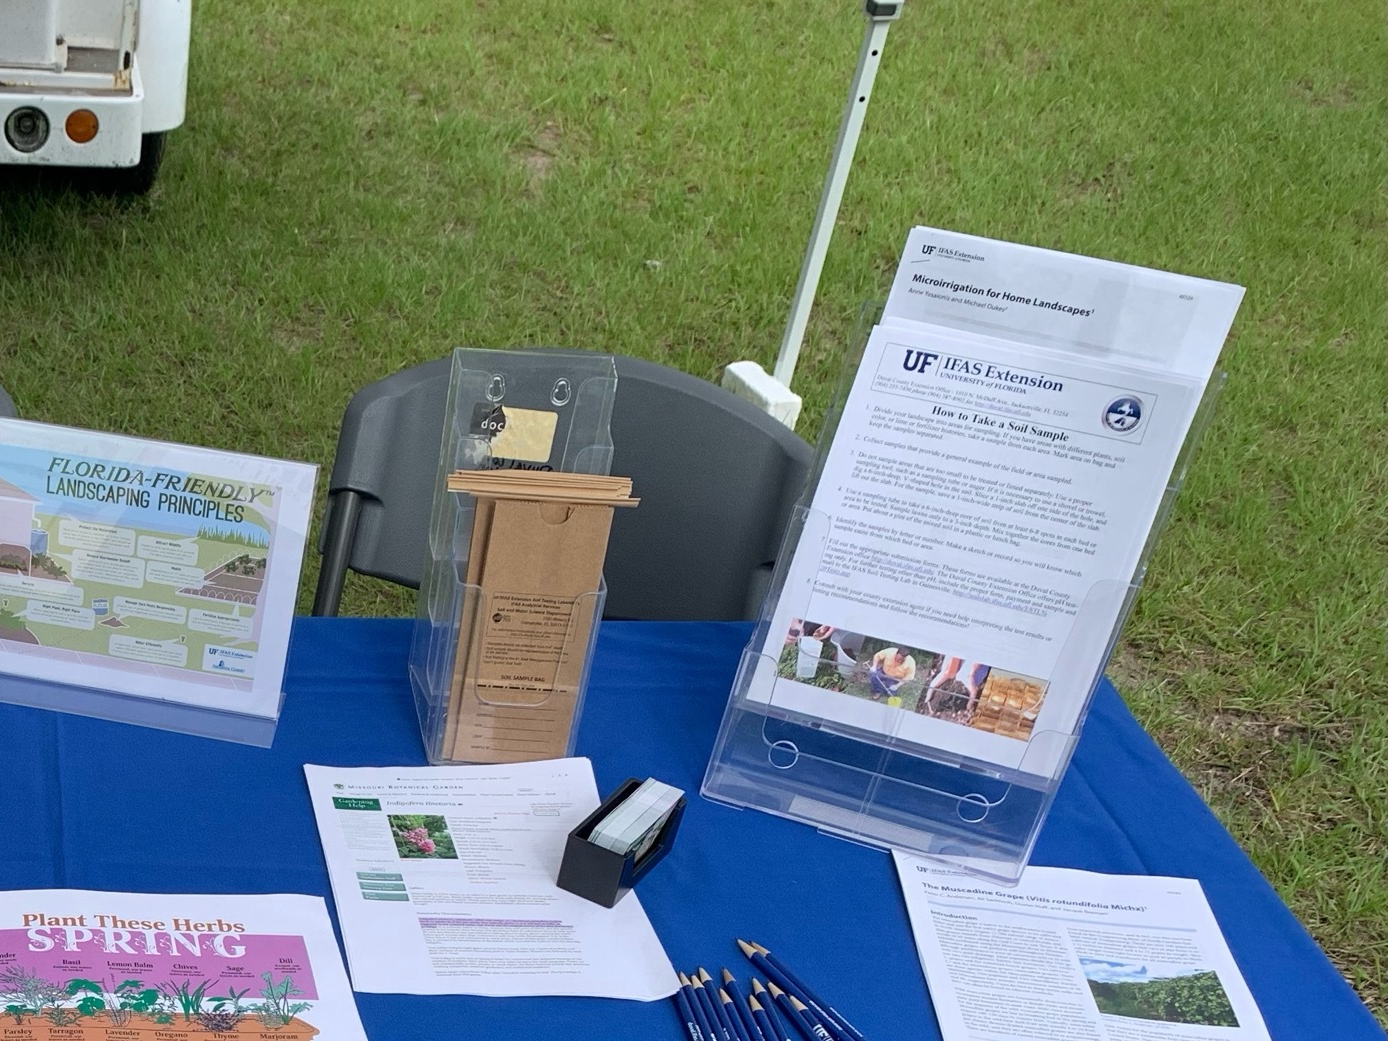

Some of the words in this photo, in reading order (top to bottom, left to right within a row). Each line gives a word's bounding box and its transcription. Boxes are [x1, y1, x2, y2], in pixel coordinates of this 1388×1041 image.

[912, 274, 985, 296] Microirrigation
[986, 288, 1001, 299] for
[1002, 292, 1031, 305] Home
[903, 349, 939, 374] UF
[943, 357, 983, 376] IFAS
[985, 365, 1063, 392] Extension
[940, 372, 985, 387] UNIVERSITY
[986, 381, 994, 389] of
[994, 383, 1027, 394] FLORIDA
[932, 405, 956, 418] How
[958, 412, 969, 421] to
[971, 414, 997, 428] Take
[1006, 421, 1028, 434] Soil
[1029, 428, 1069, 444] Sample
[46, 475, 150, 508] LANDSCAPING
[158, 492, 244, 523] PRINCIPLES
[922, 882, 939, 890] The
[941, 886, 993, 896] Muscadine
[995, 891, 1024, 900] Grape
[1026, 895, 1050, 903] (Vitis
[1052, 898, 1109, 909] rotundifolia
[22, 913, 87, 927] Plant
[94, 914, 166, 930] These
[172, 918, 245, 933] Herbs
[27, 927, 246, 958] SPRING
